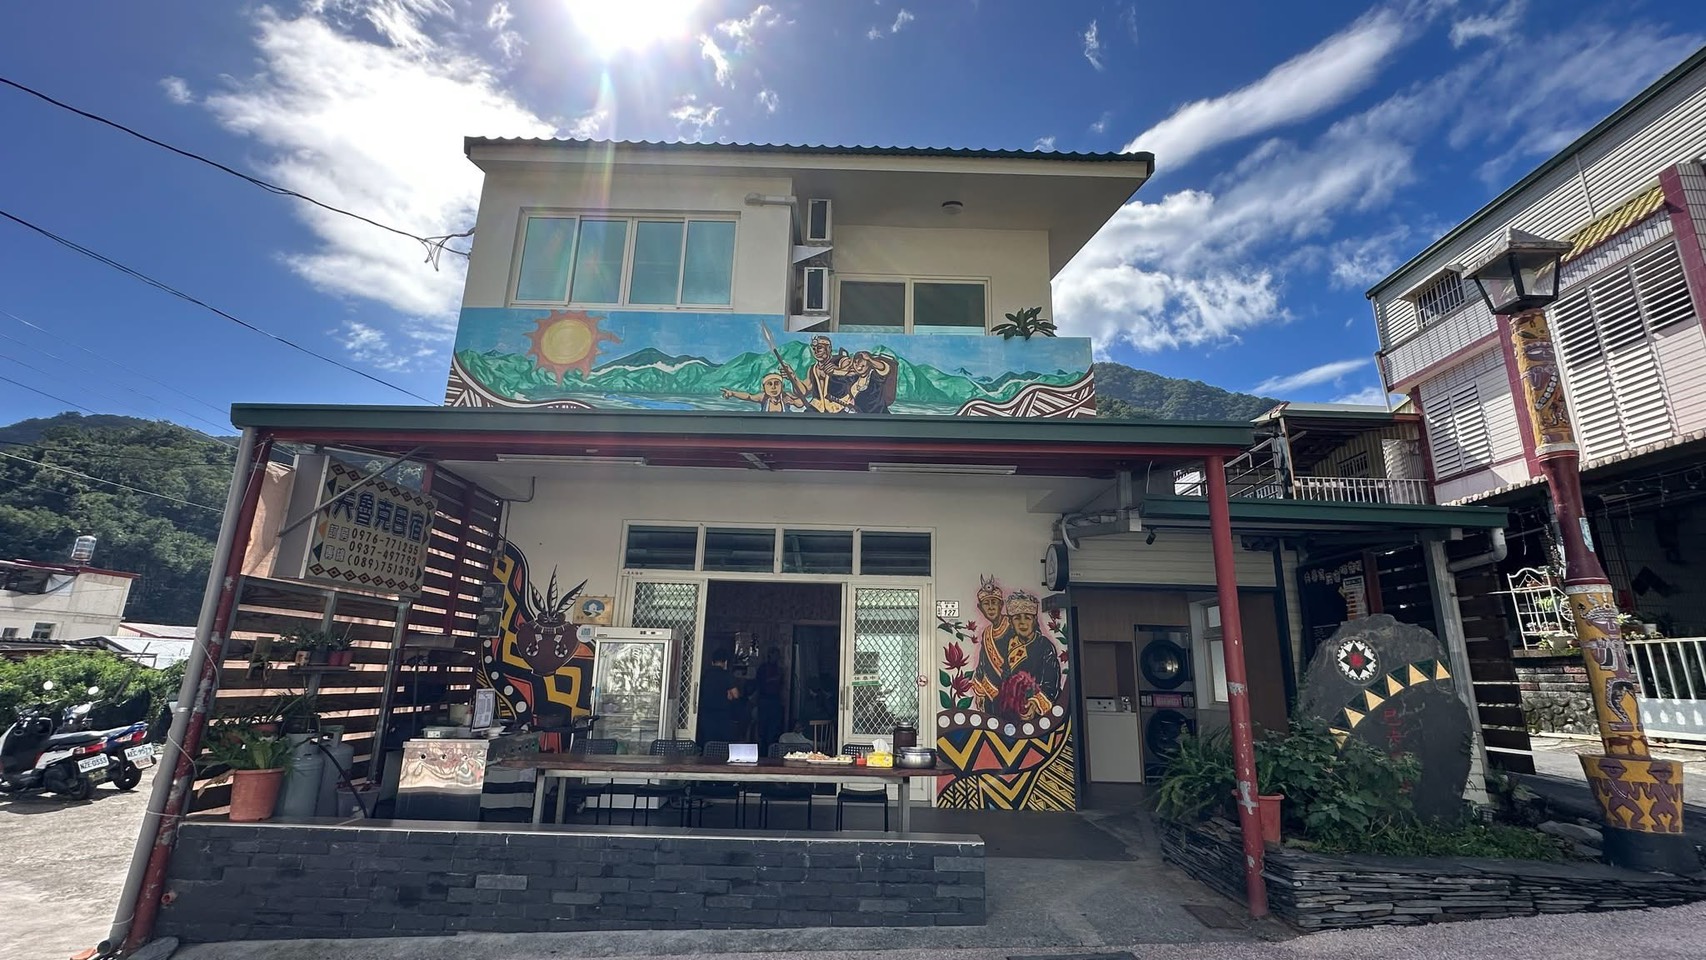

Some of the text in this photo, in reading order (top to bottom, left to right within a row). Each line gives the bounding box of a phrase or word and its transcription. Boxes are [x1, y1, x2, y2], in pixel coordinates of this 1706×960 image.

[349, 541, 416, 566] 0937-497793
[351, 528, 419, 555] 0976-771255
[347, 554, 415, 578] (089)751396
